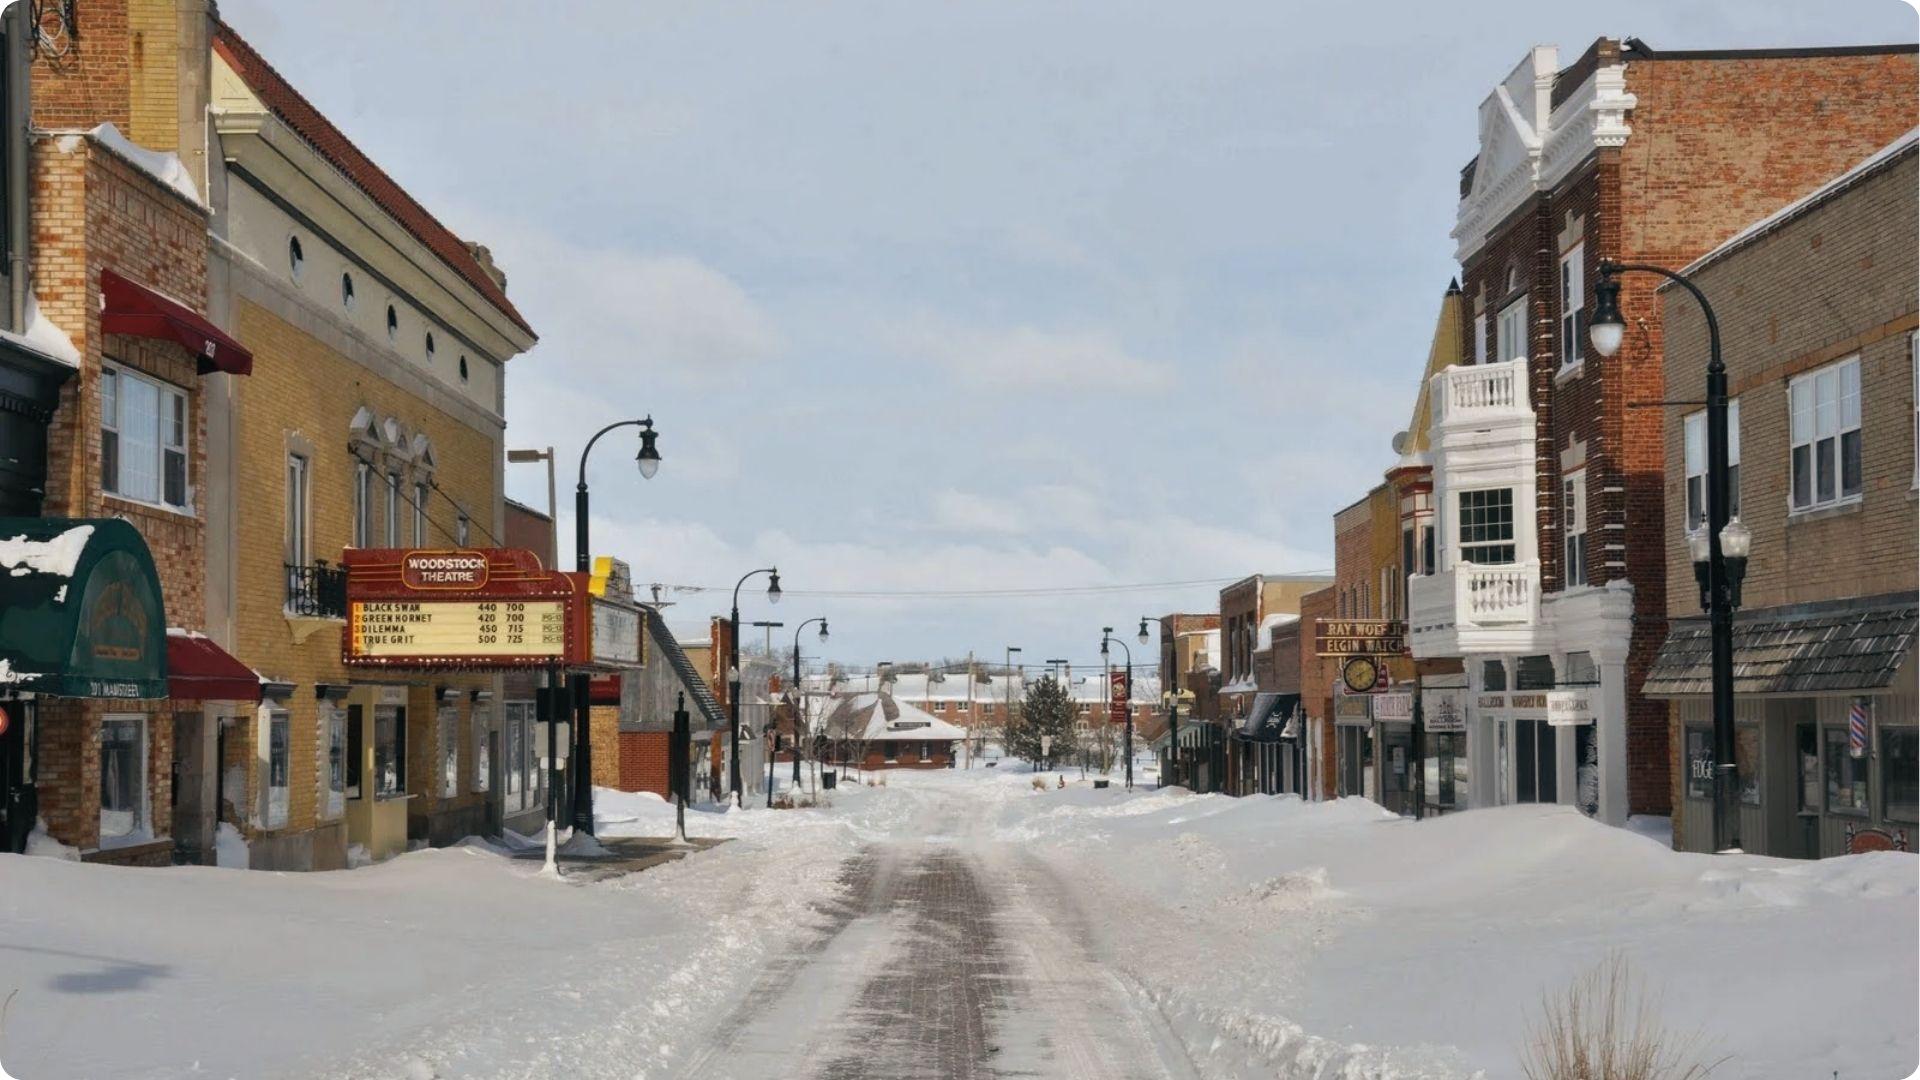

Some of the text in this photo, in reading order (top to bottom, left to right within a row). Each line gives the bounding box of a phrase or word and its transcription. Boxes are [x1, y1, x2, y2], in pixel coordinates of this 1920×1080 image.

[408, 558, 486, 570] WOODSTOCK
[421, 571, 475, 582] THEATRE
[363, 603, 392, 612] BLACK
[395, 603, 420, 612] SWAN
[478, 603, 525, 612] 440 700
[362, 614, 393, 622] GREEN
[395, 613, 433, 622] HORNET
[478, 613, 525, 622] 420 700
[361, 625, 405, 633] DILEMMA
[480, 624, 524, 633] 450 715
[1327, 623, 1352, 636] RAY
[1356, 623, 1388, 636] WOLF
[363, 635, 388, 644] TRUE
[390, 635, 415, 644] GRIT
[478, 635, 523, 644] 500 725
[1327, 639, 1359, 652] ELGIN
[1692, 759, 1713, 779] EDGE
